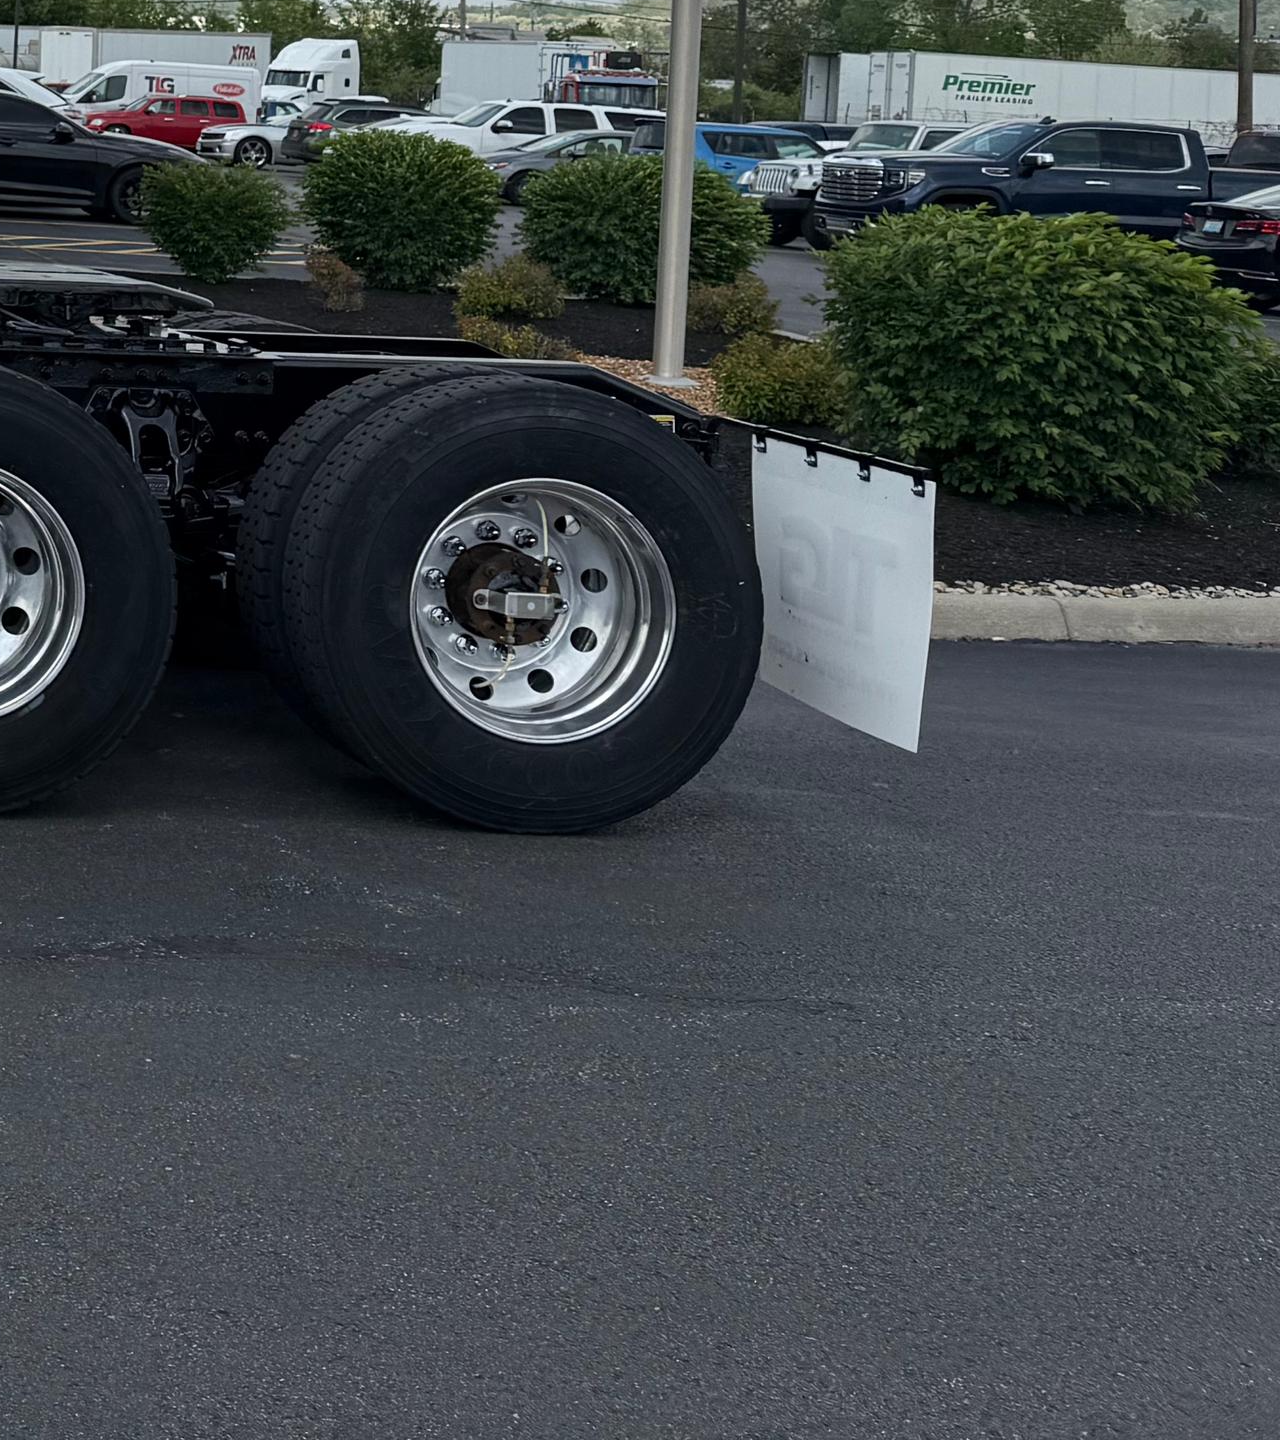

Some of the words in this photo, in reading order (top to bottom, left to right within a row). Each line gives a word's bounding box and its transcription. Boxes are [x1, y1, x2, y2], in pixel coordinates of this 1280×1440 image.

[228, 44, 256, 65] XTRA
[145, 75, 175, 94] TLG
[942, 74, 1036, 96] Premier
[955, 94, 993, 102] TRAILER
[995, 97, 1034, 105] LEASING
